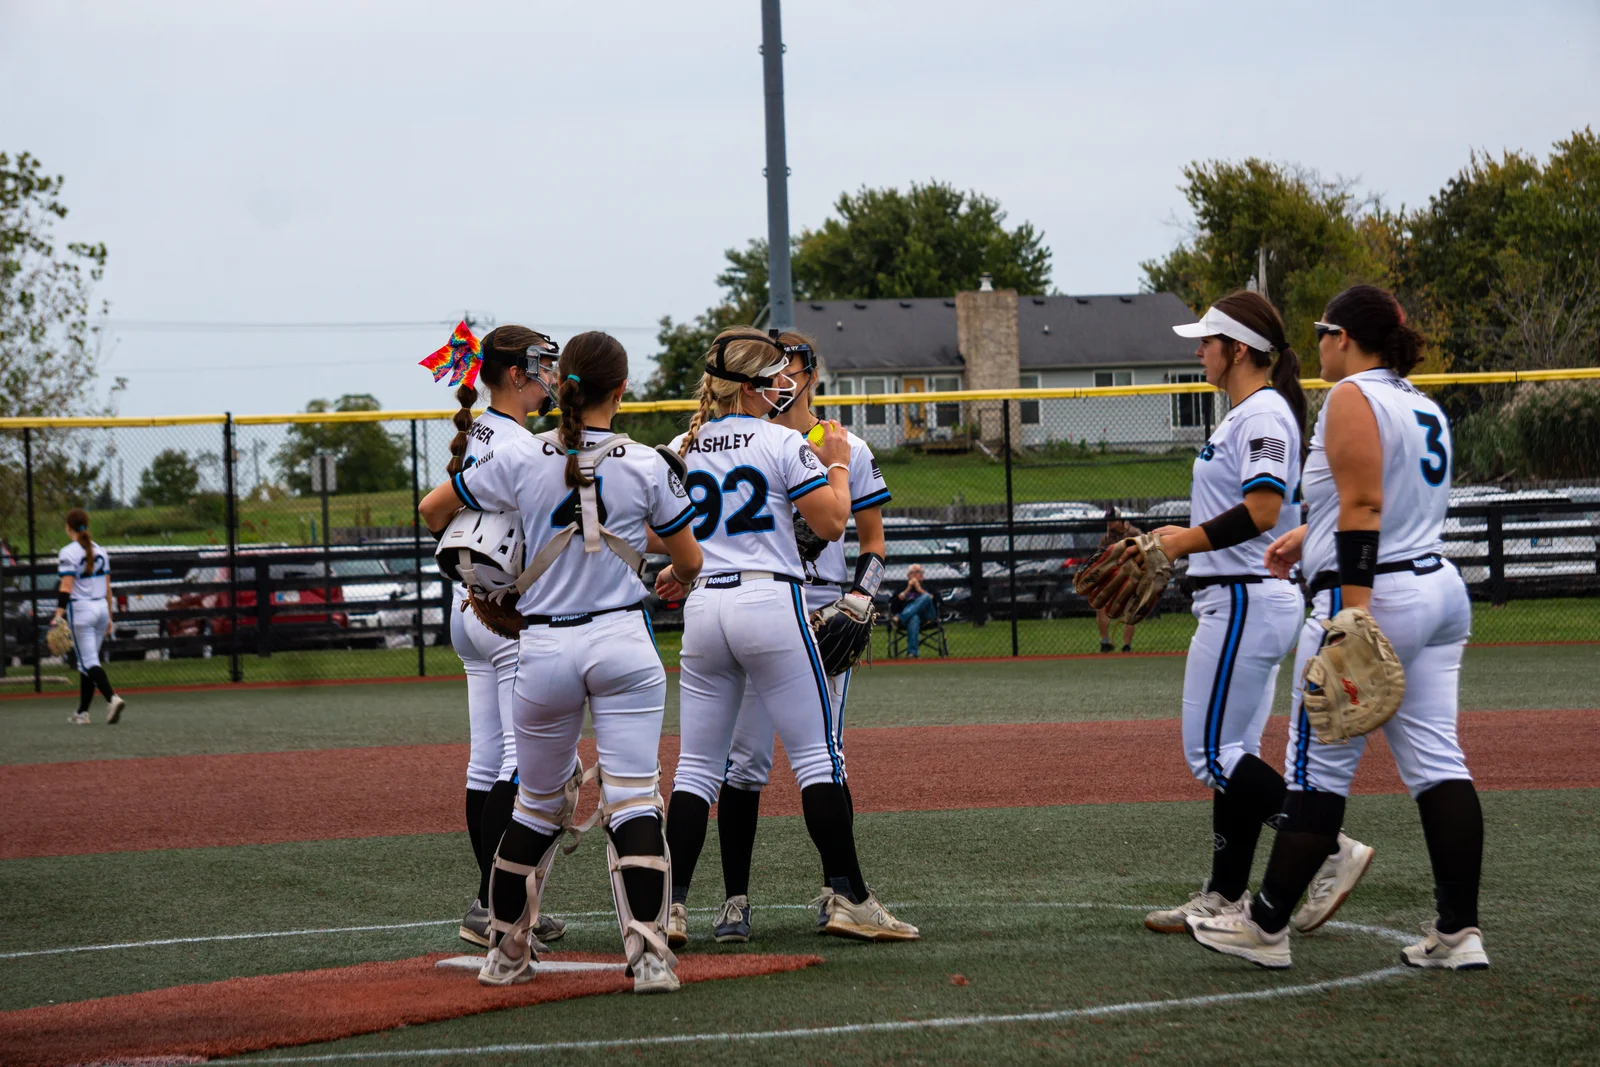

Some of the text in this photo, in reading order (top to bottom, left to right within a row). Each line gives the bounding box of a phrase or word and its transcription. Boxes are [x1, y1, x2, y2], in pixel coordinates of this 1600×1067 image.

[688, 433, 755, 454] ASHLEY
[1412, 409, 1448, 488] 3
[684, 464, 775, 542] 92
[707, 573, 739, 584] BOMBERS
